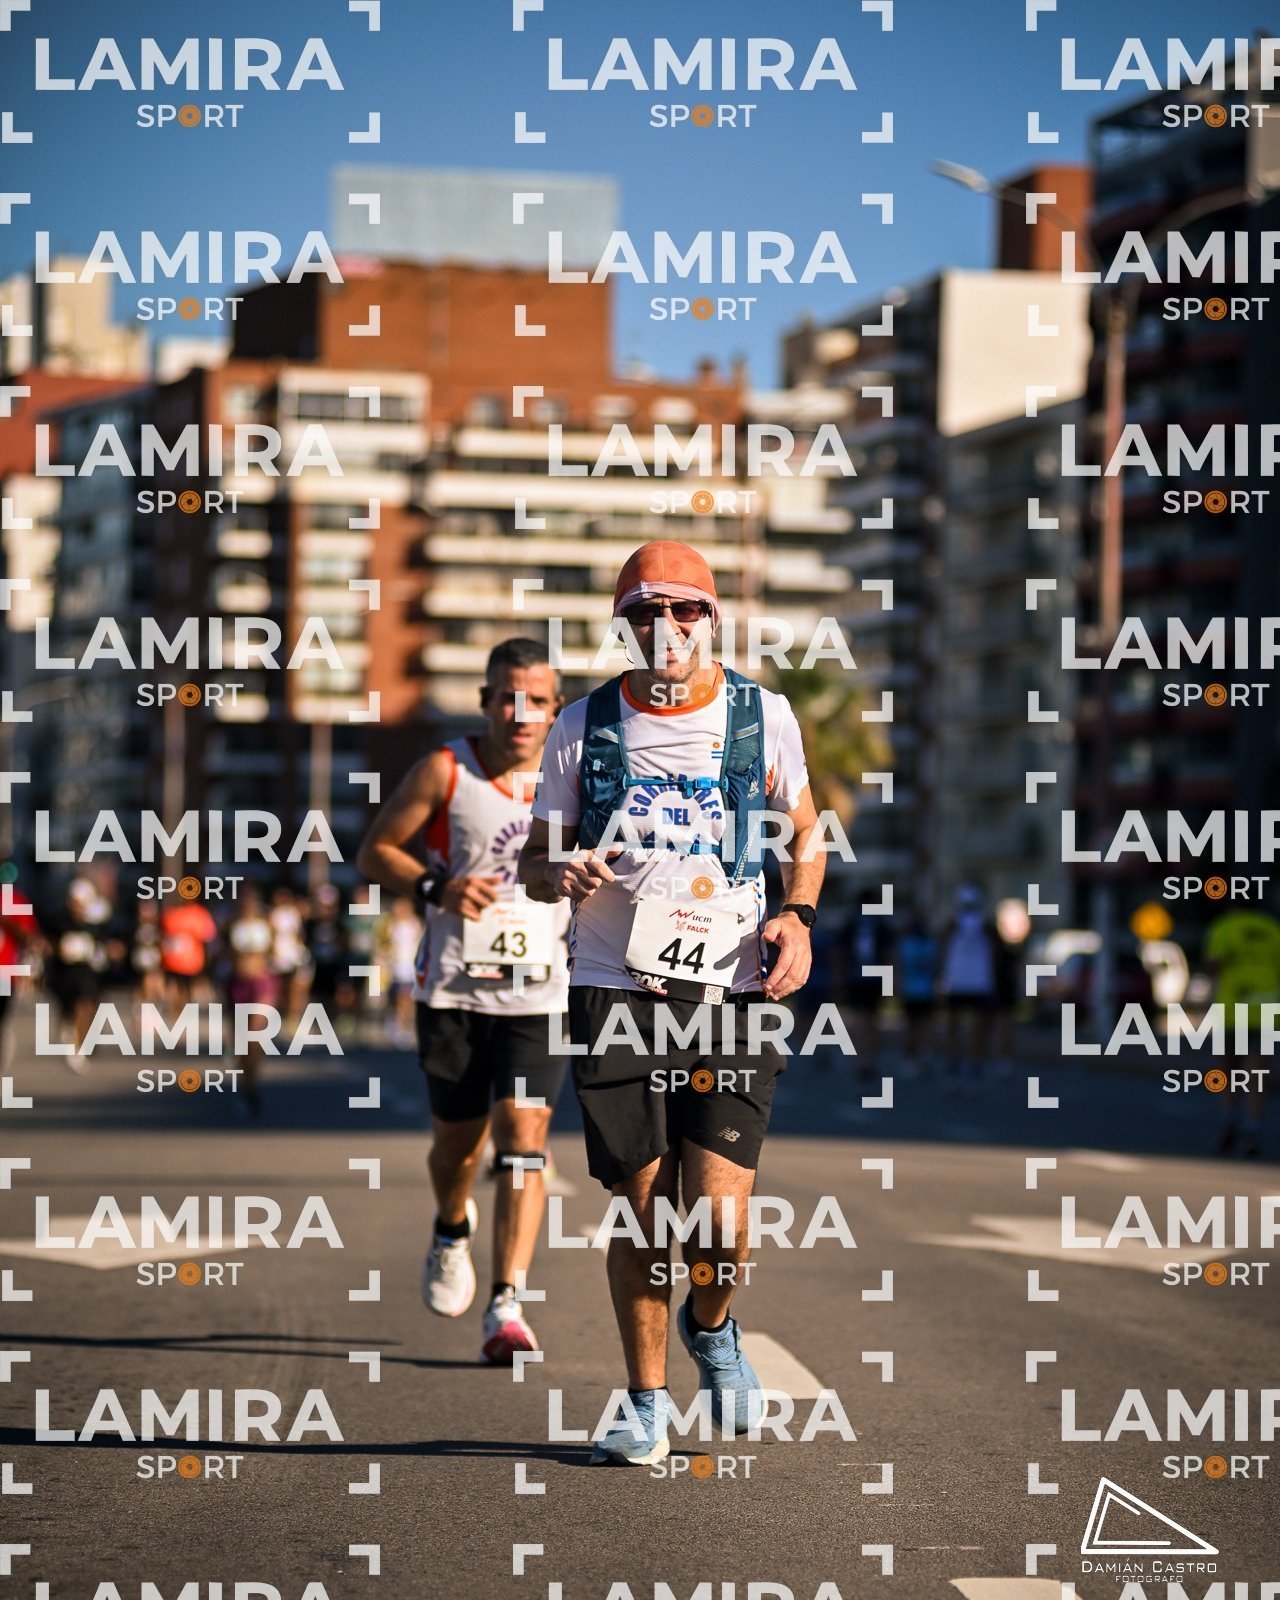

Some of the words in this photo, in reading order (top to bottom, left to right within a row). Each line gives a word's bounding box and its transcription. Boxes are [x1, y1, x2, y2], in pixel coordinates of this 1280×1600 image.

[662, 807, 691, 826] DEL
[686, 925, 710, 934] FALCK
[490, 931, 527, 957] 43
[658, 938, 706, 974] 44
